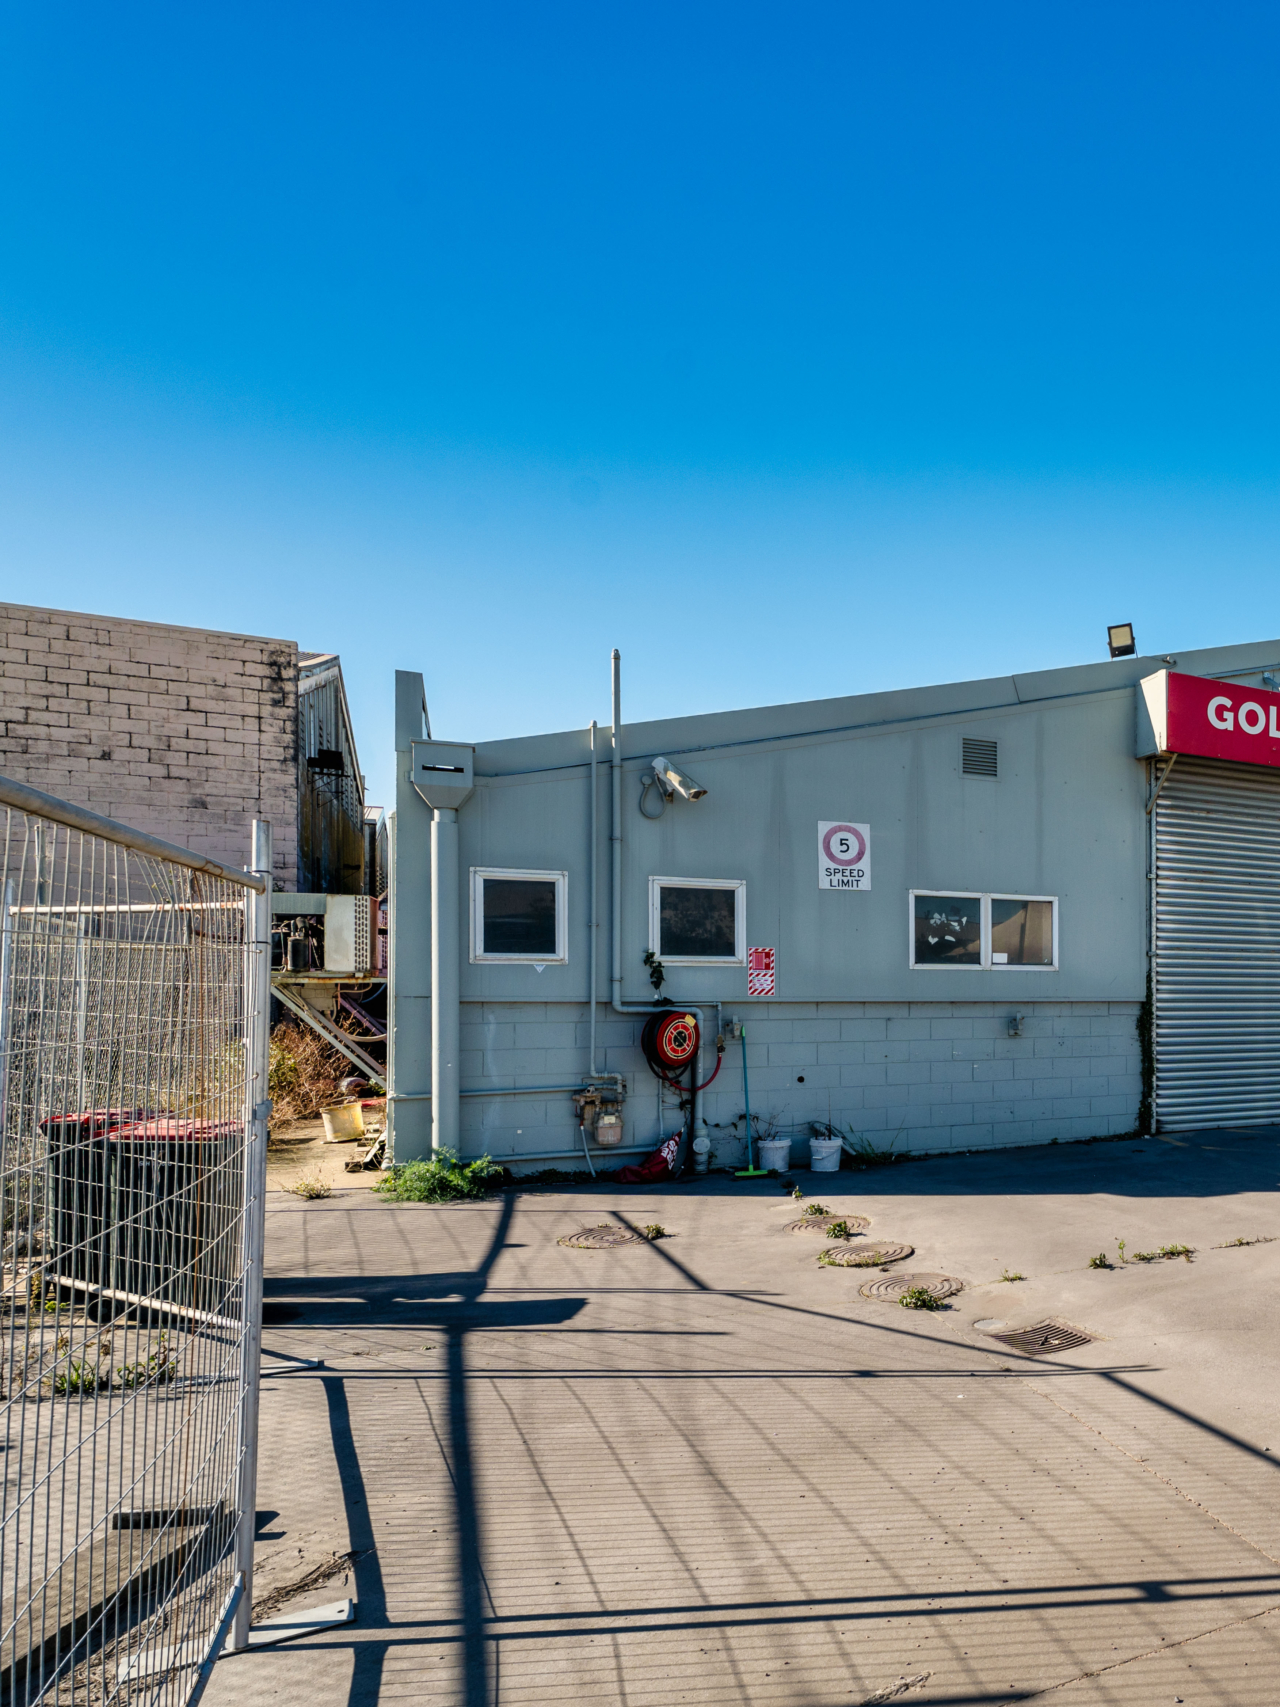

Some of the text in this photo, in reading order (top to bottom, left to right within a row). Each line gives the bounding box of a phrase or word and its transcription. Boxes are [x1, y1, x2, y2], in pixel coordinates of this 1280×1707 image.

[839, 838, 850, 853] 5
[825, 867, 865, 878] SPEED
[829, 878, 861, 888] LIMIT
